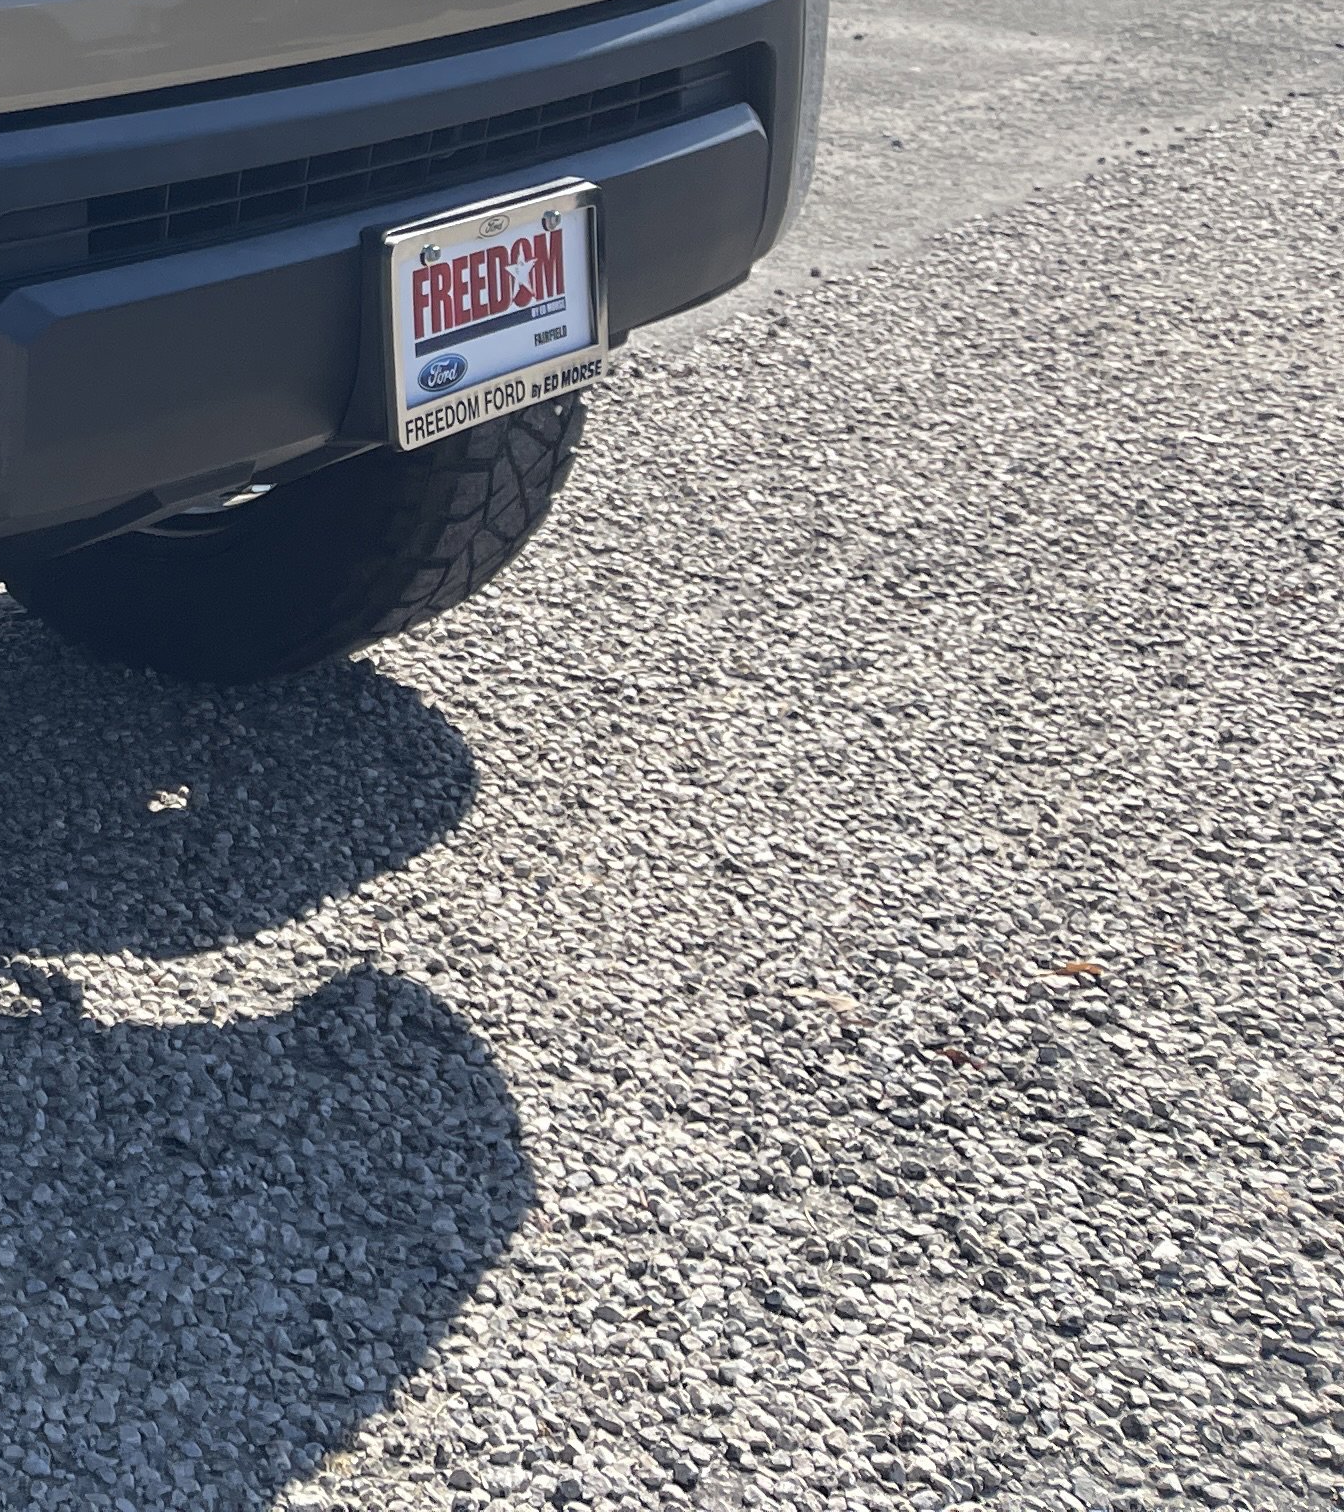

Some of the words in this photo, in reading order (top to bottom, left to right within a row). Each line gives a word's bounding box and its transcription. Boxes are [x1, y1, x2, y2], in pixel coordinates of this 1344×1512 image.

[412, 228, 565, 340] FREEDOM
[405, 398, 481, 445] FREEDOM
[484, 379, 526, 415] FORD
[544, 374, 559, 394] ED
[561, 359, 603, 389] MORSE
[427, 360, 459, 388] Ford
